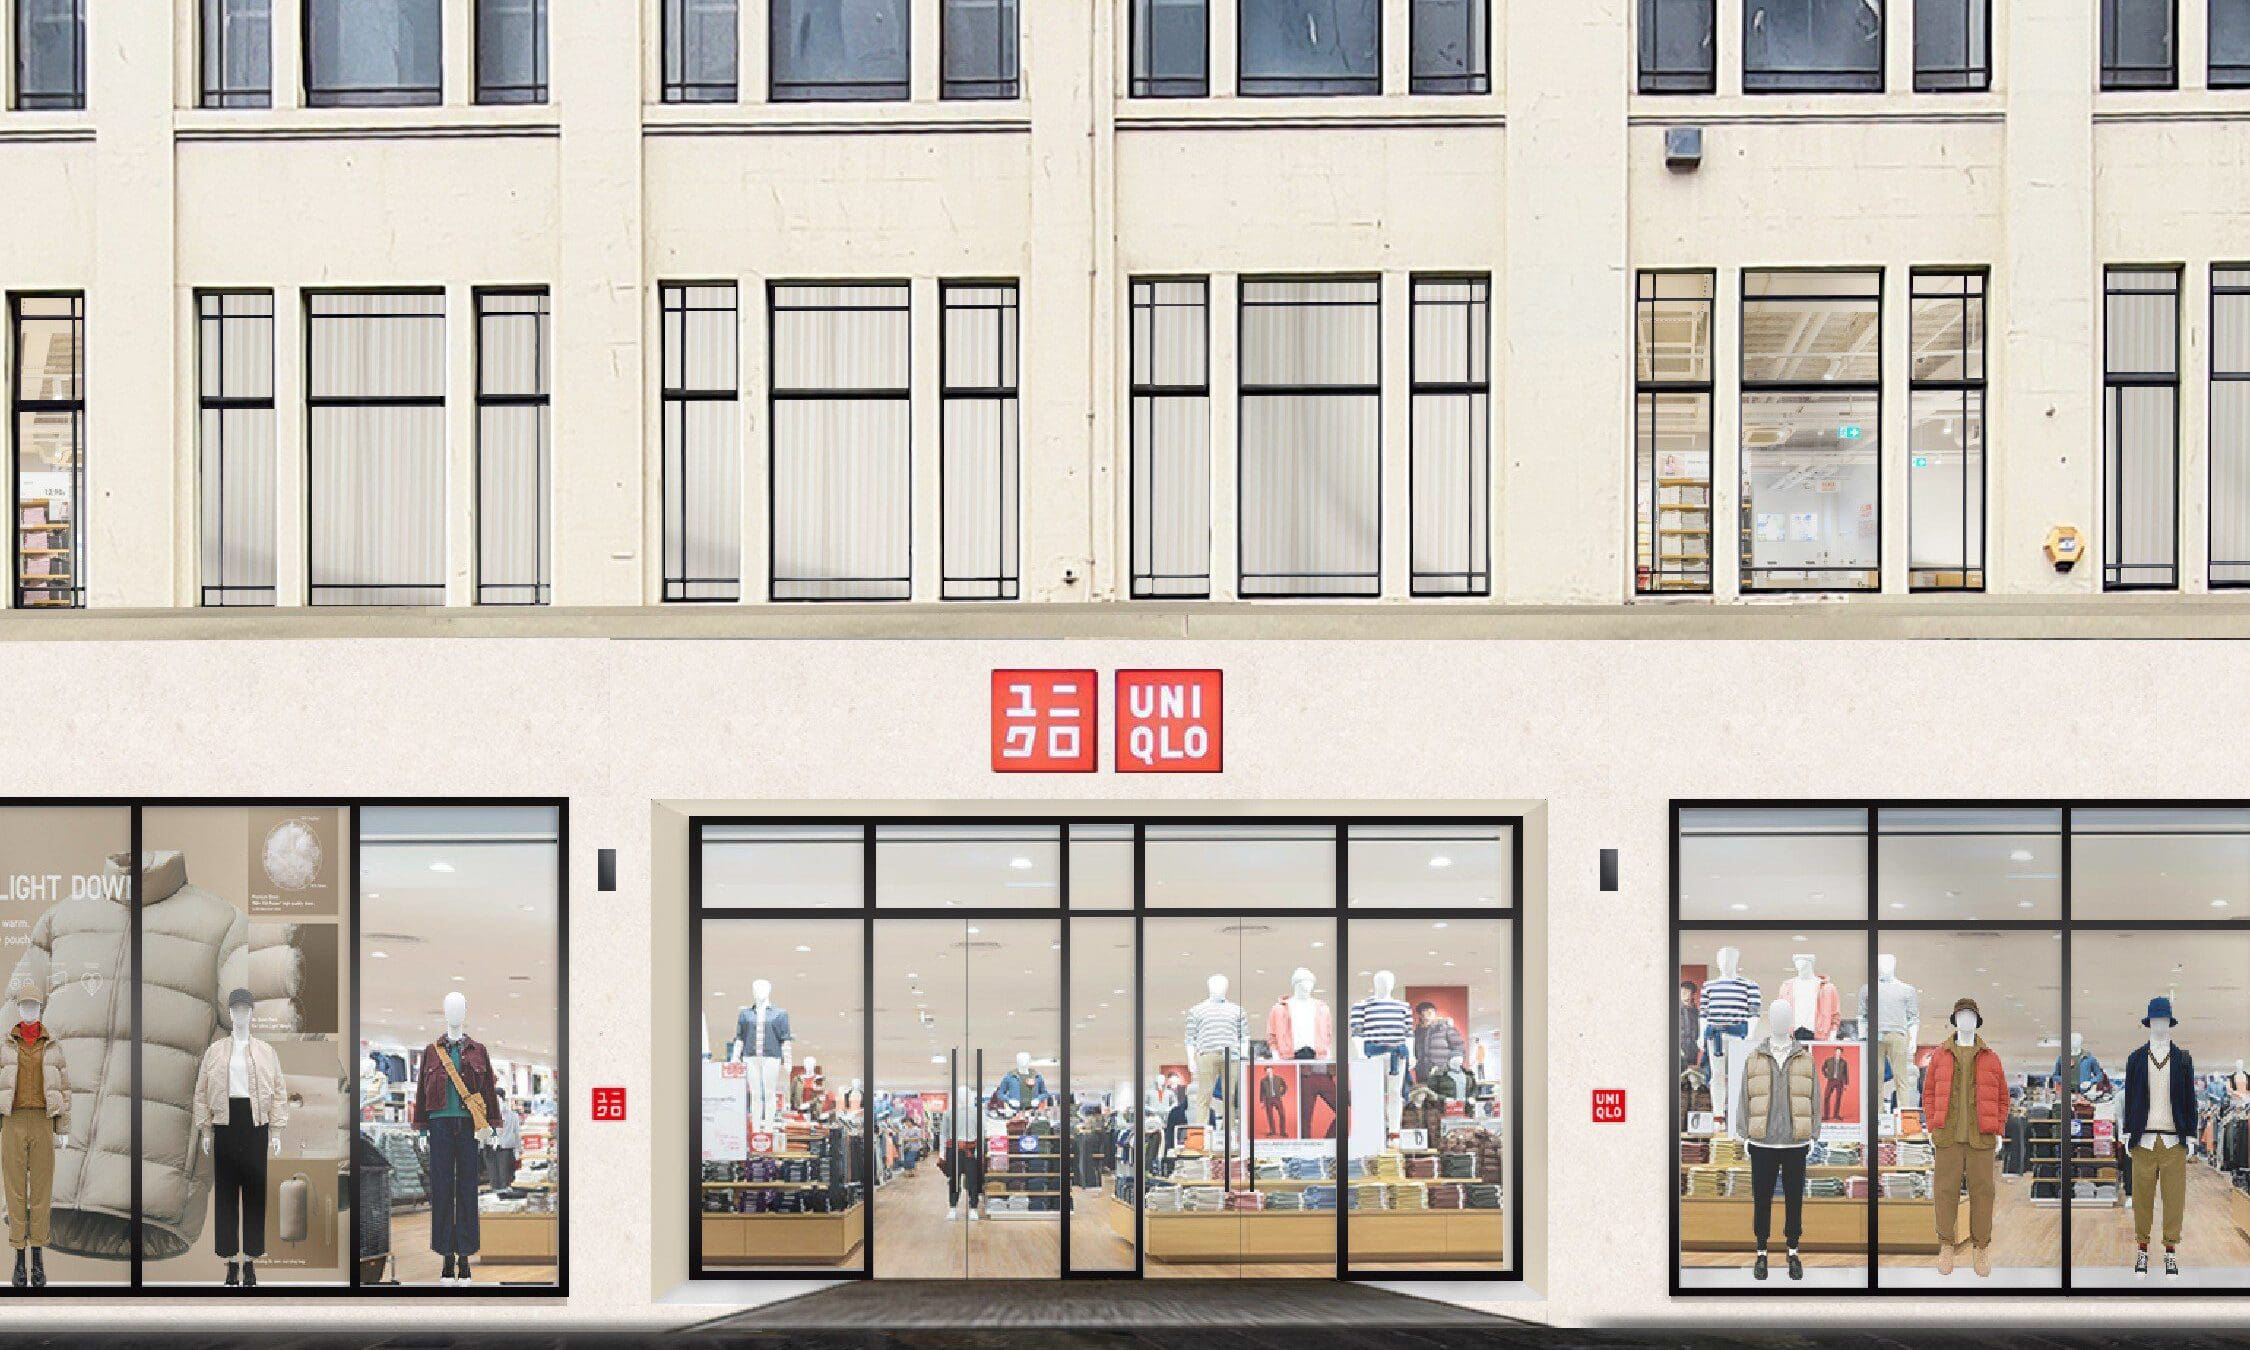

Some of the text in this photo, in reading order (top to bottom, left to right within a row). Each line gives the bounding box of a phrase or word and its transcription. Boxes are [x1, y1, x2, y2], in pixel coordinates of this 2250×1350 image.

[1005, 684, 1080, 718] ユニ
[1130, 684, 1201, 718] UNI
[1003, 725, 1080, 759] クロ
[1130, 725, 1208, 766] QLO
[597, 1092, 621, 1104] ユニ
[1596, 1093, 1619, 1105] UNI
[597, 1105, 621, 1117] クロ
[1596, 1106, 1622, 1120] QLO
